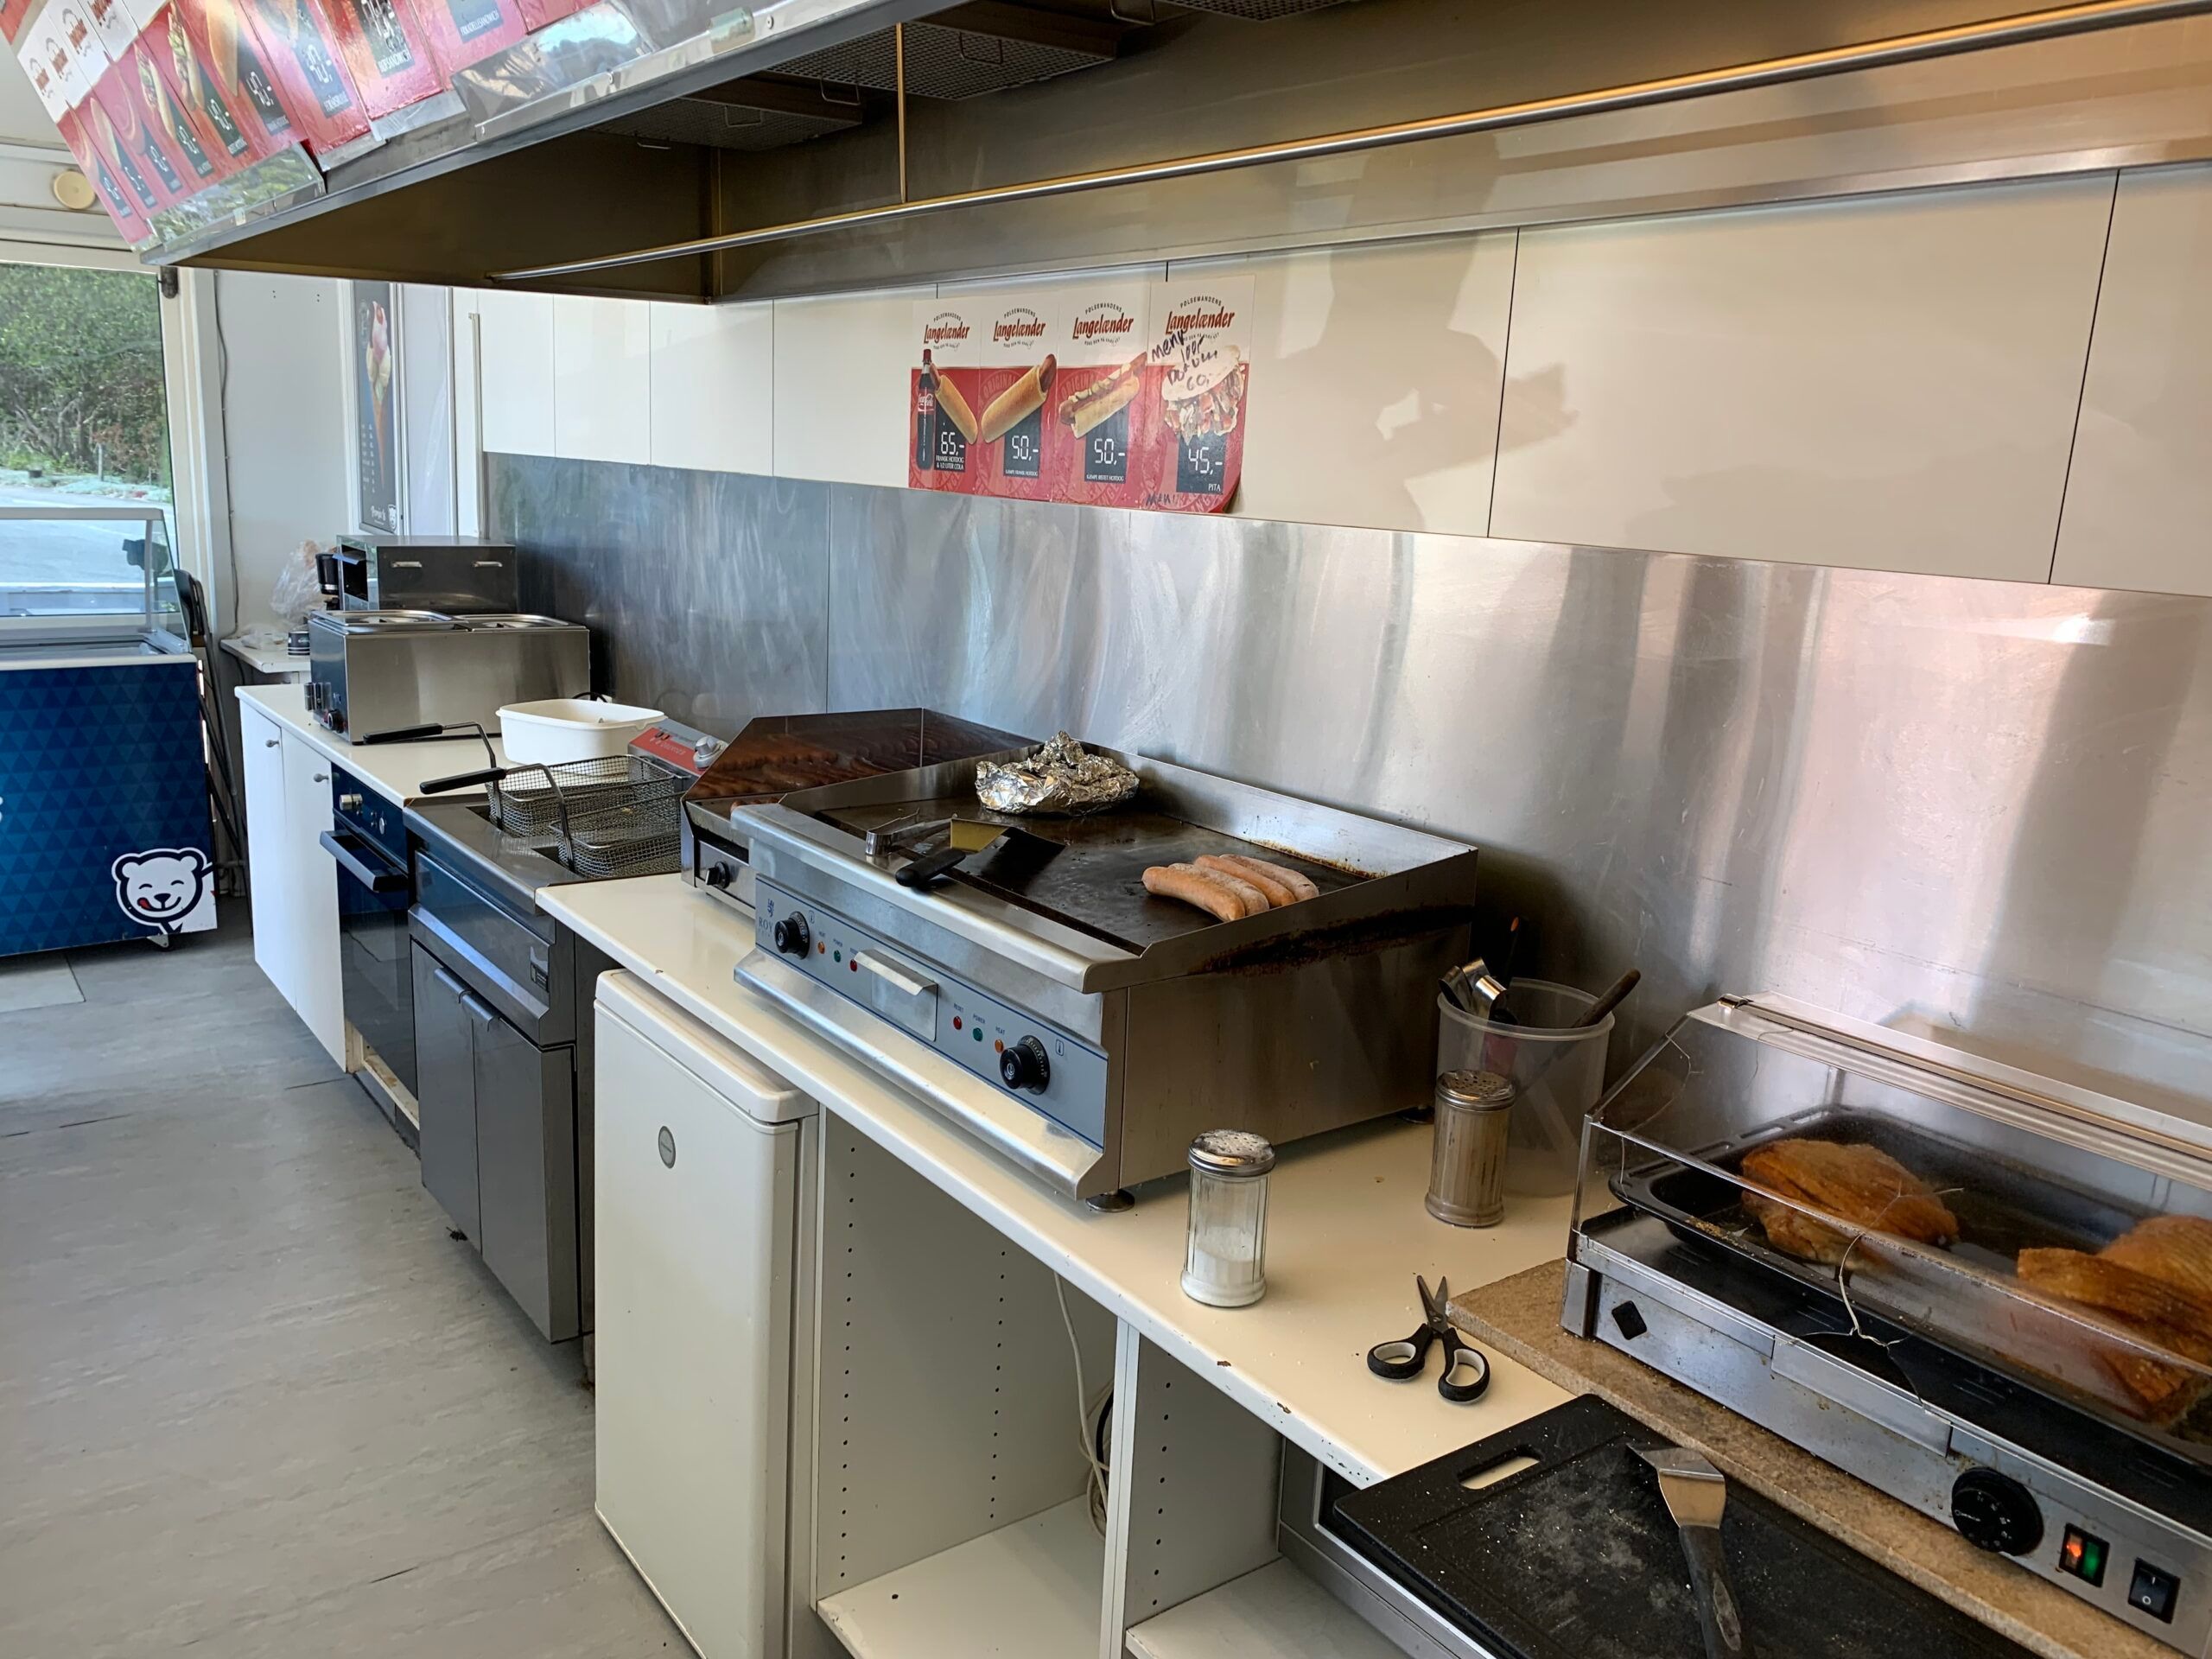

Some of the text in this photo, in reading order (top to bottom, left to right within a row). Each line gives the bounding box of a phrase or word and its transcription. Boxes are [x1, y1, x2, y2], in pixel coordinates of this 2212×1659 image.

[1179, 296, 1222, 308] PØLSEMANDENS
[924, 321, 970, 344] Langelænder
[993, 317, 1046, 342] Langelænder
[1072, 312, 1135, 340] Langelænder
[1166, 306, 1236, 335] Langelænder
[940, 431, 965, 455] 65,-
[1011, 435, 1039, 461] 50,-
[1094, 438, 1126, 465] 50,-
[1188, 447, 1223, 475] 45,-
[1208, 483, 1221, 492] PITA
[953, 1002, 964, 1013] RESET
[972, 1014, 986, 1025] POWER
[995, 1027, 1006, 1036] HEAT
